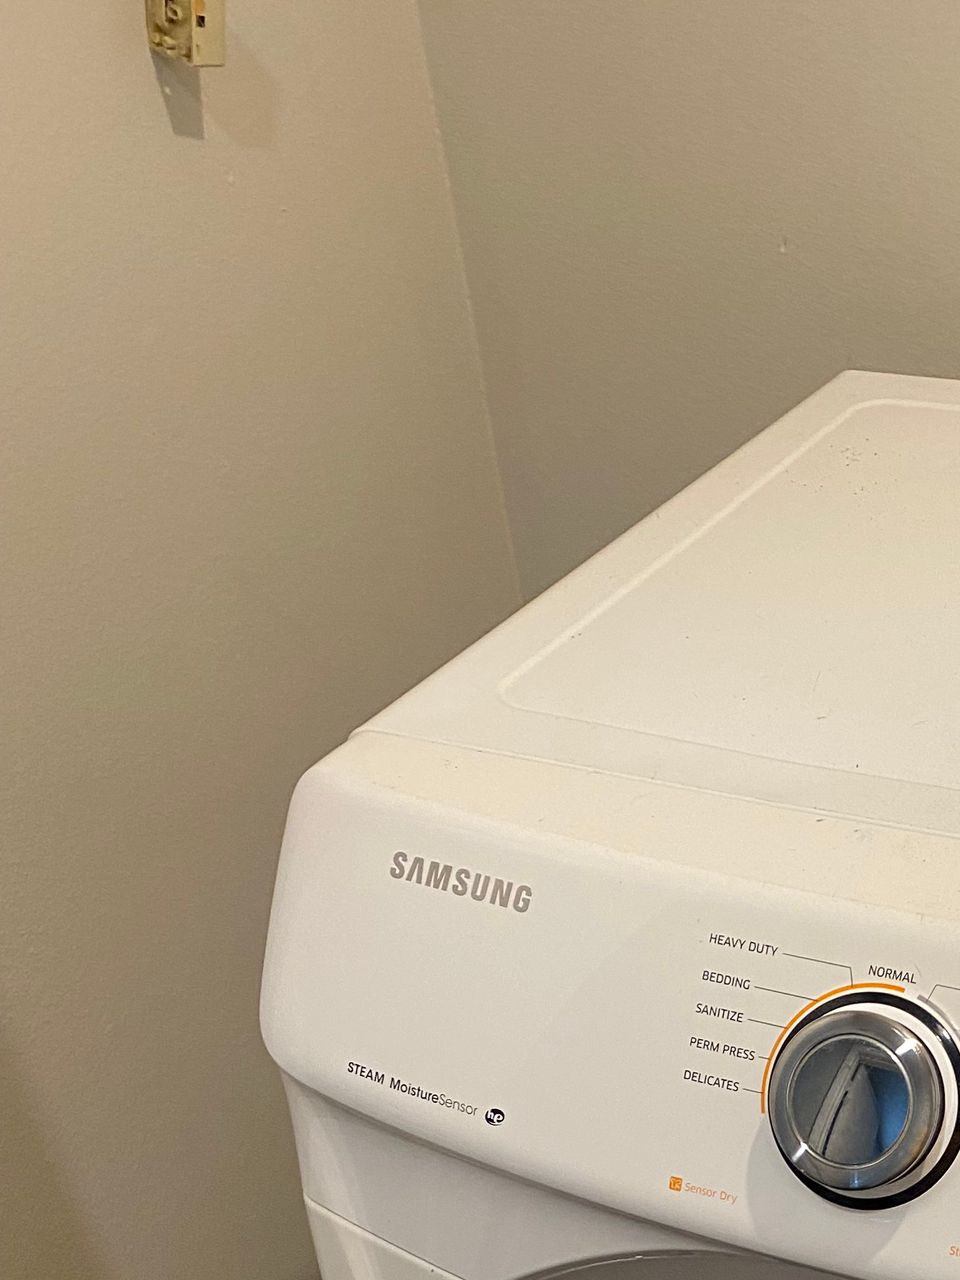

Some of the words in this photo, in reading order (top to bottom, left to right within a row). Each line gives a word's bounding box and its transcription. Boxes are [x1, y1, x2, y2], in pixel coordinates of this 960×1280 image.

[390, 851, 532, 913] SAMSUNG
[709, 933, 746, 950] HEAVY
[748, 941, 778, 956] DUTY
[702, 970, 751, 990] BEDDING
[868, 965, 917, 984] NORMAL
[695, 1003, 744, 1023] SANITIZE
[689, 1037, 720, 1053] PERM
[722, 1045, 755, 1061] PRESS
[347, 1061, 385, 1085] STEAM
[389, 1077, 478, 1116] MoistureSensor
[683, 1069, 740, 1092] DELICATES
[685, 1182, 717, 1198] Sensor
[720, 1190, 738, 1205] Dry
